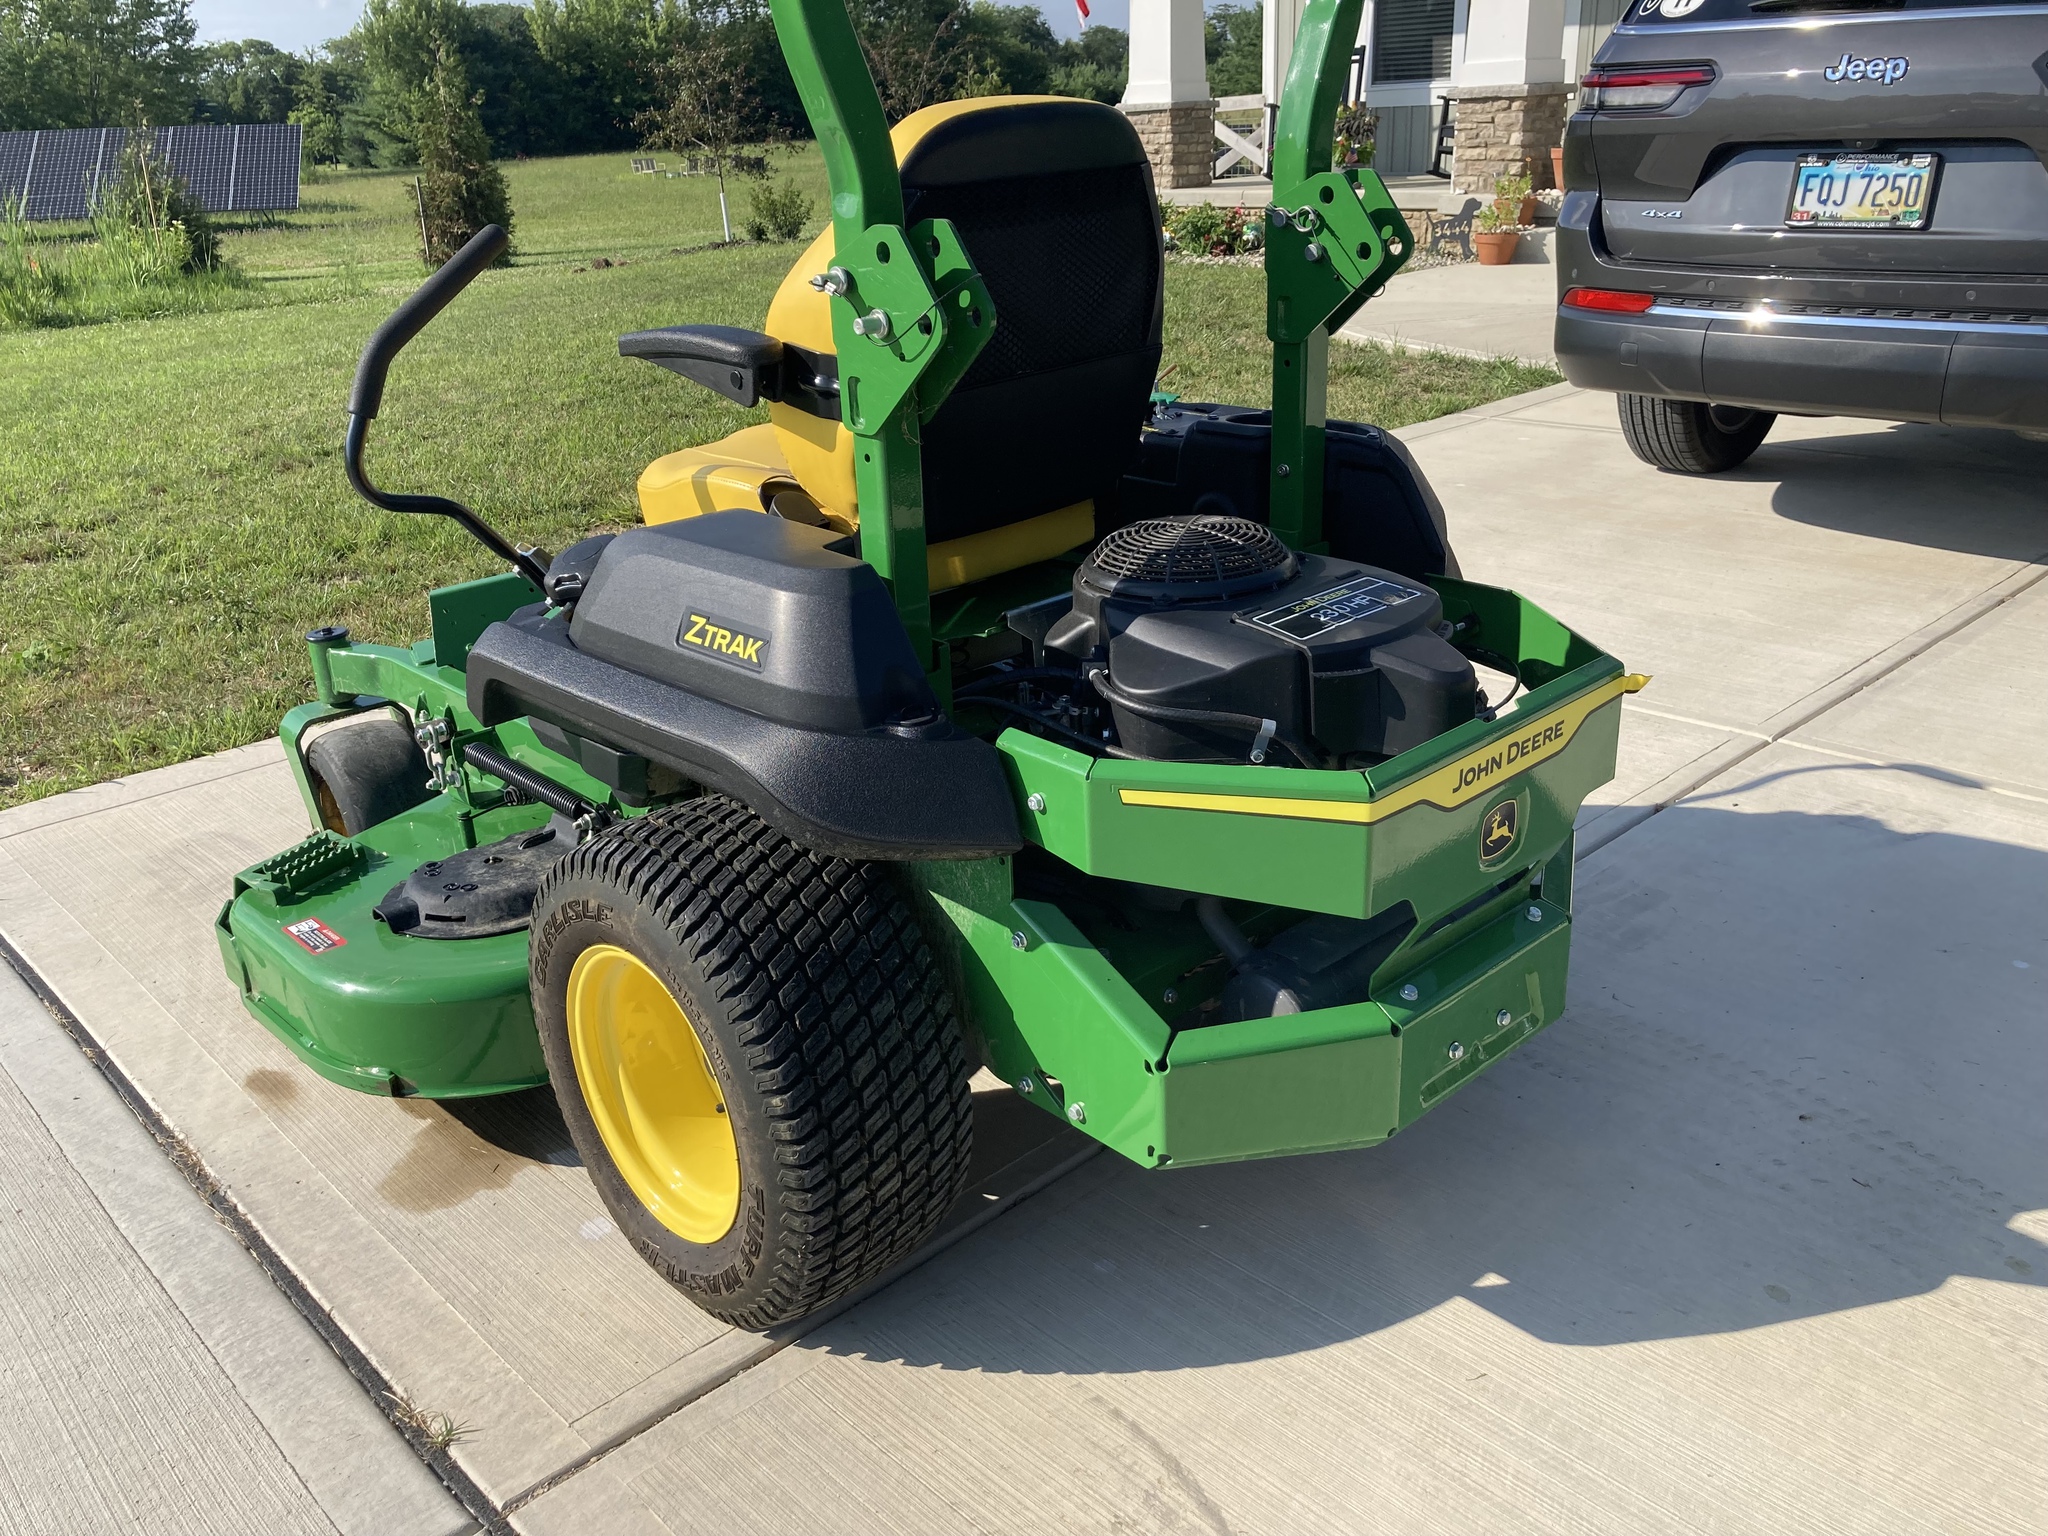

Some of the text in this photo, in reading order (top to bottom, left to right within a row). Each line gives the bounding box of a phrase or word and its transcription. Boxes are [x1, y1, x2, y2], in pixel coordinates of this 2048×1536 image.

[1824, 53, 1909, 86] Jeep
[1800, 173, 1922, 207] FQJ 7250
[1434, 220, 1470, 237] 3444
[1641, 209, 1682, 219] 4x4
[1291, 588, 1352, 613] JOHN DEERE
[684, 614, 764, 663] ZTRAK
[1452, 720, 1565, 793] JOHN DEERE
[535, 899, 614, 988] CARLISLE
[640, 1182, 765, 1296] TURF MASTER
